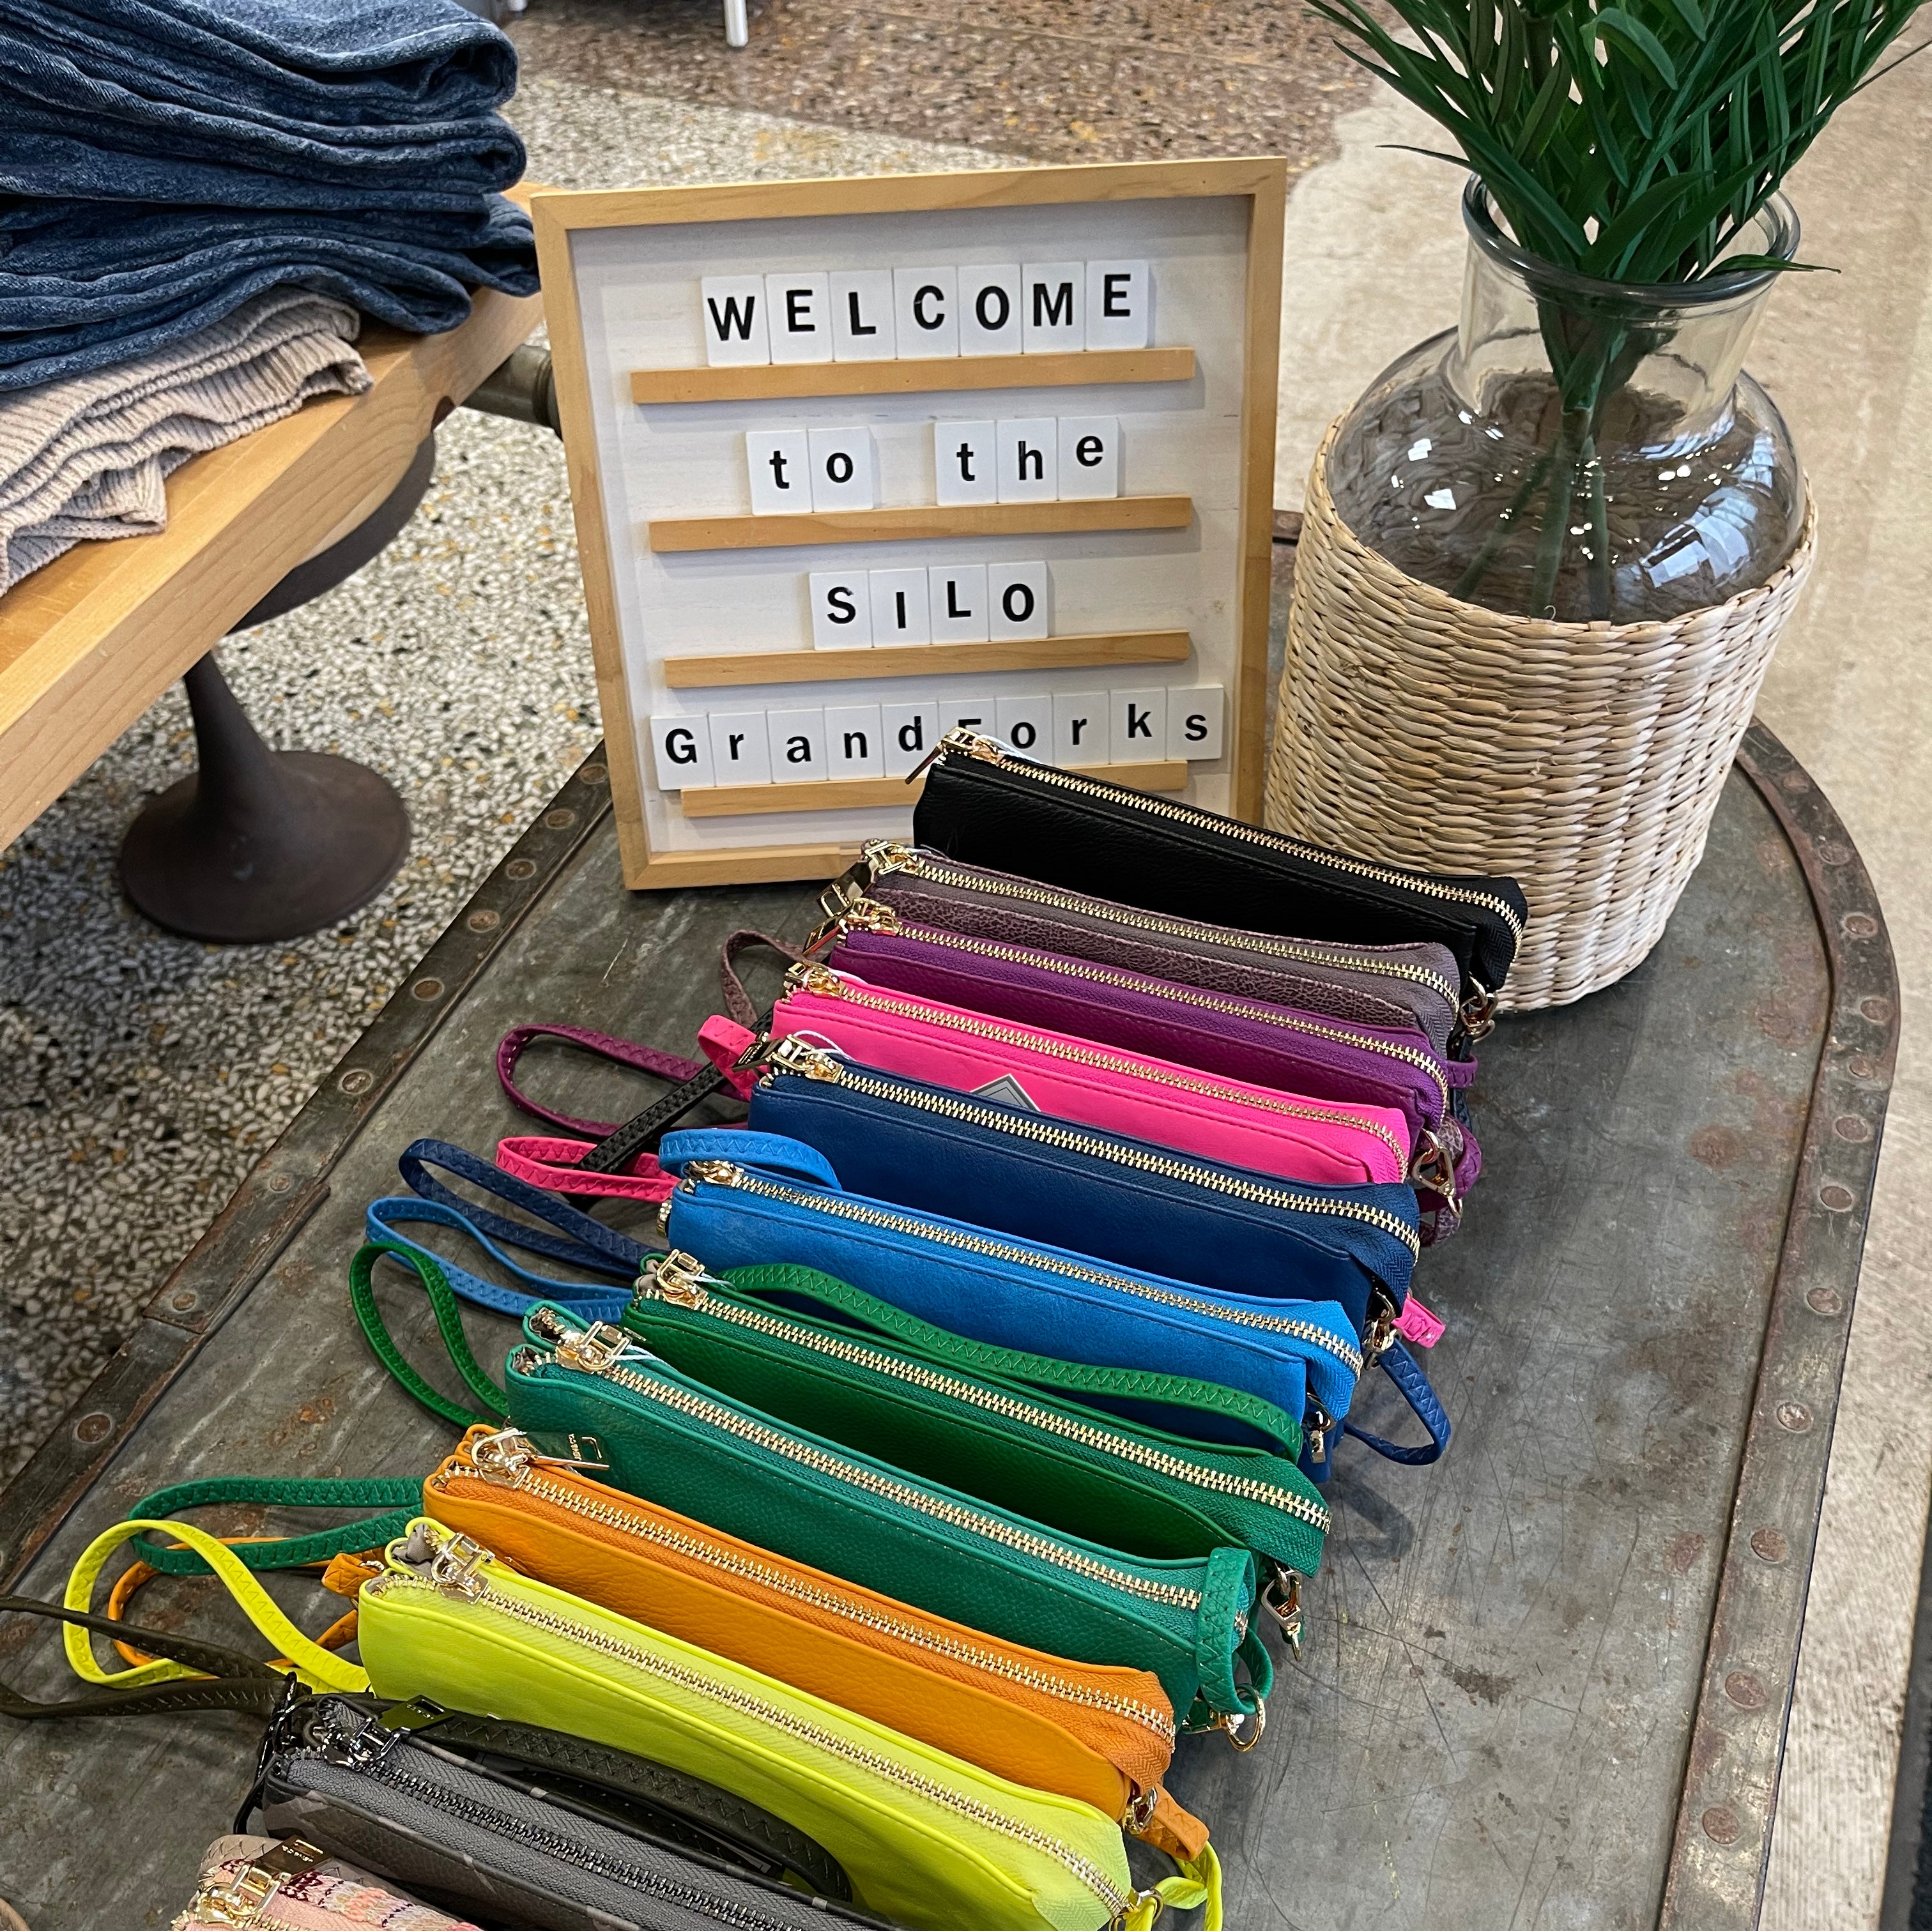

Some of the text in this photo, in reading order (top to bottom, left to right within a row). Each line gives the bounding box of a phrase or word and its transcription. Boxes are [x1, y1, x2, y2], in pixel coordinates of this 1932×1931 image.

[707, 273, 1131, 342] WELCOME
[769, 435, 1104, 490] to the
[827, 581, 1035, 629] SILO
